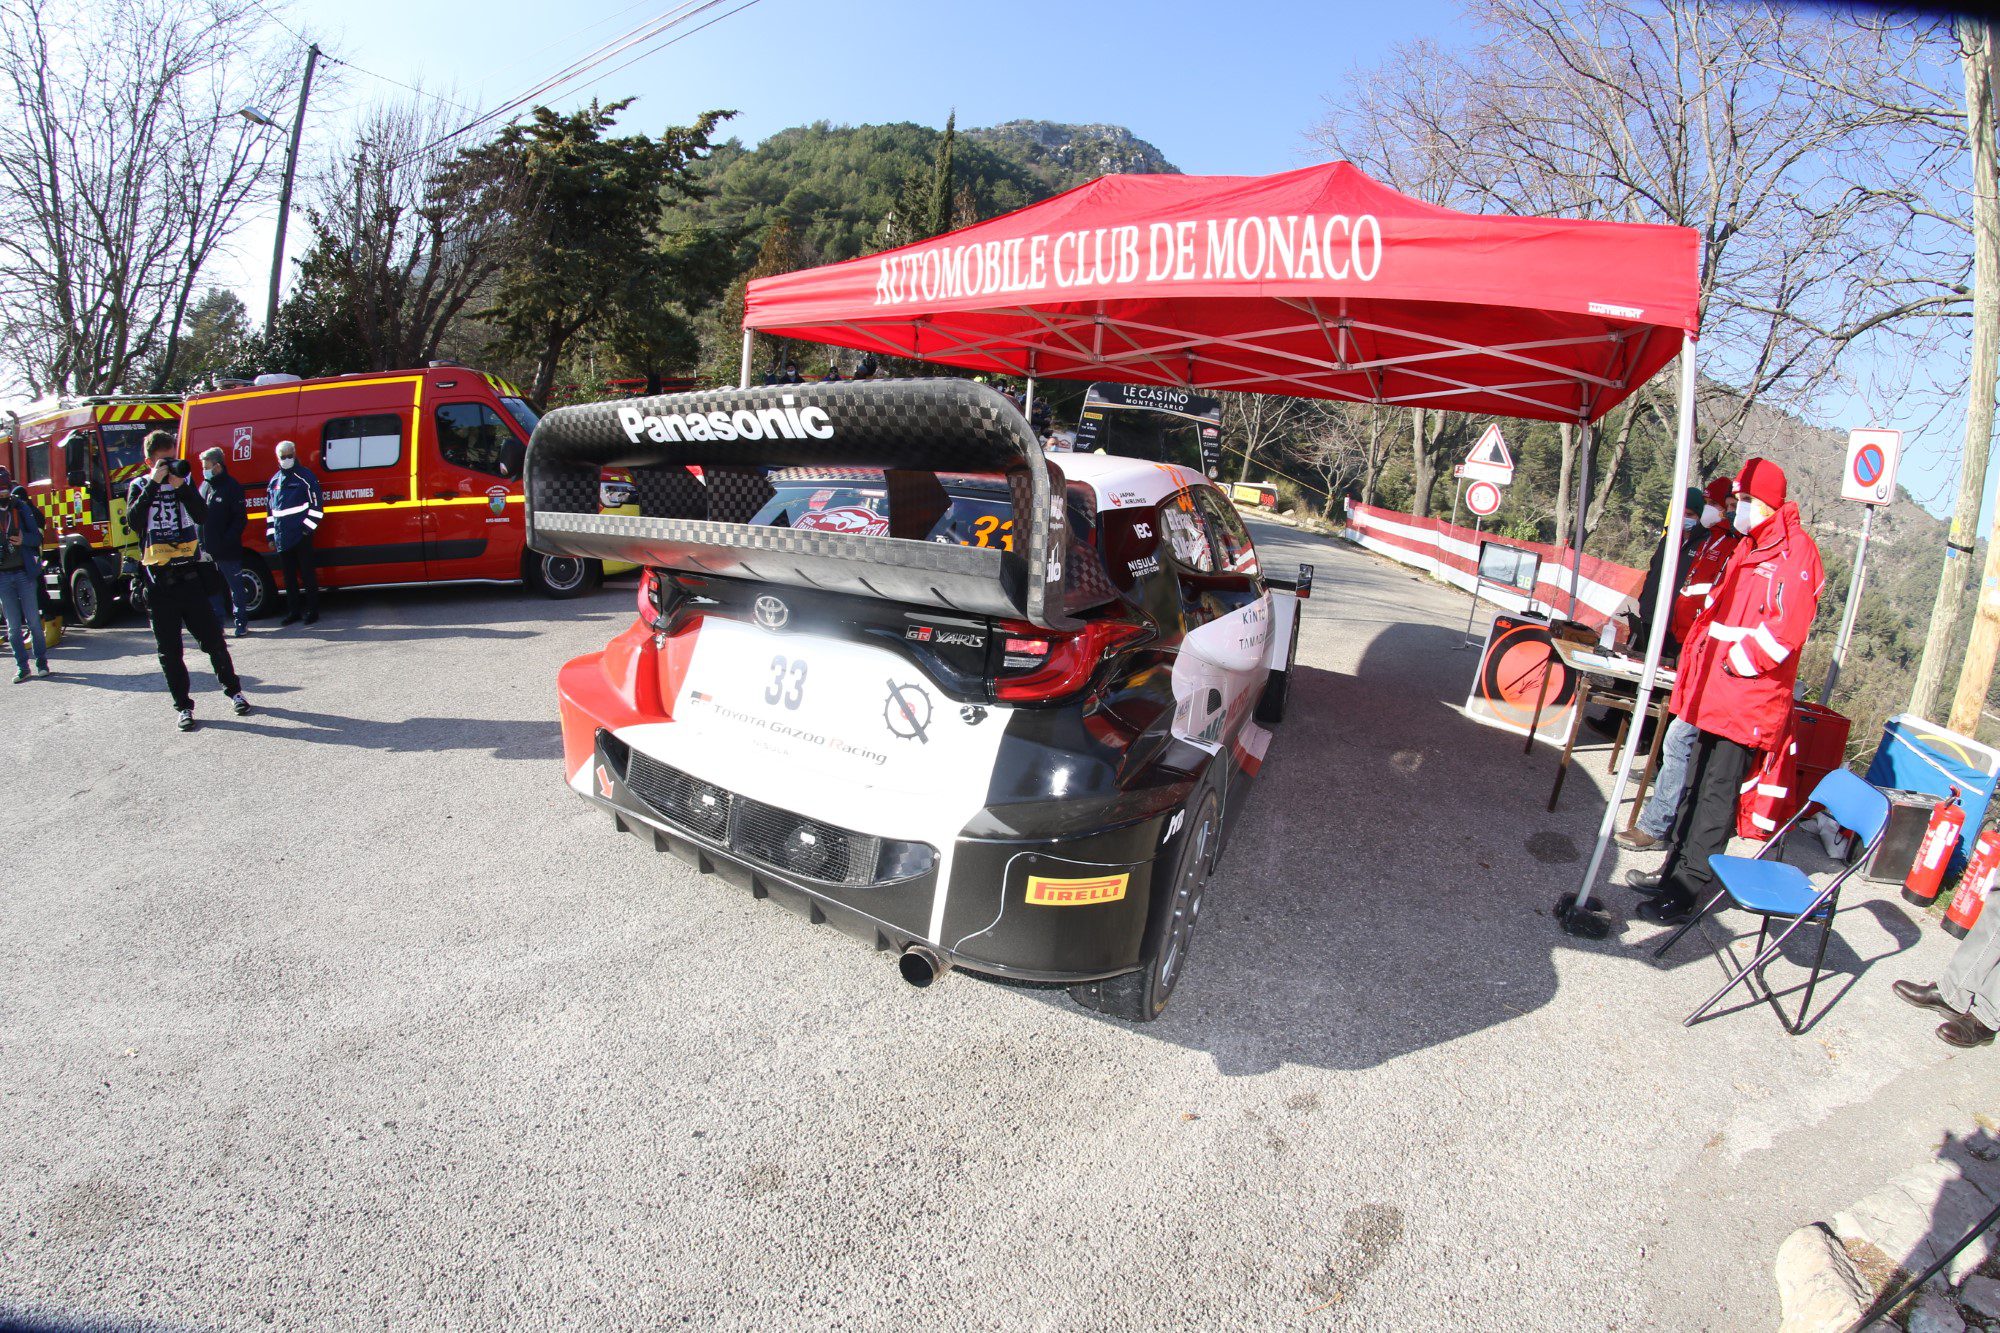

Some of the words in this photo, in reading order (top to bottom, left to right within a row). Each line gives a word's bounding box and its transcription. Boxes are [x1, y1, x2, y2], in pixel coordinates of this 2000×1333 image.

[874, 234, 1048, 306] AUTOMOBILE
[1053, 224, 1140, 287] CLUB
[1146, 221, 1196, 281] DE
[1203, 214, 1382, 281] MONACO
[1123, 385, 1136, 398] LE
[1138, 388, 1189, 405] CASINO
[617, 393, 835, 444] Panasonic
[239, 445, 250, 459] 18
[332, 490, 344, 499] AUX
[345, 488, 374, 499] VICTIMES
[1127, 556, 1158, 571] NISULA
[907, 631, 929, 641] GR
[935, 630, 985, 648] YARIS
[764, 655, 808, 711] 33
[711, 703, 758, 729] TOYOTA
[769, 721, 825, 746] GAZOO
[828, 736, 888, 767] Racing
[1034, 878, 1122, 901] PIRELLI
